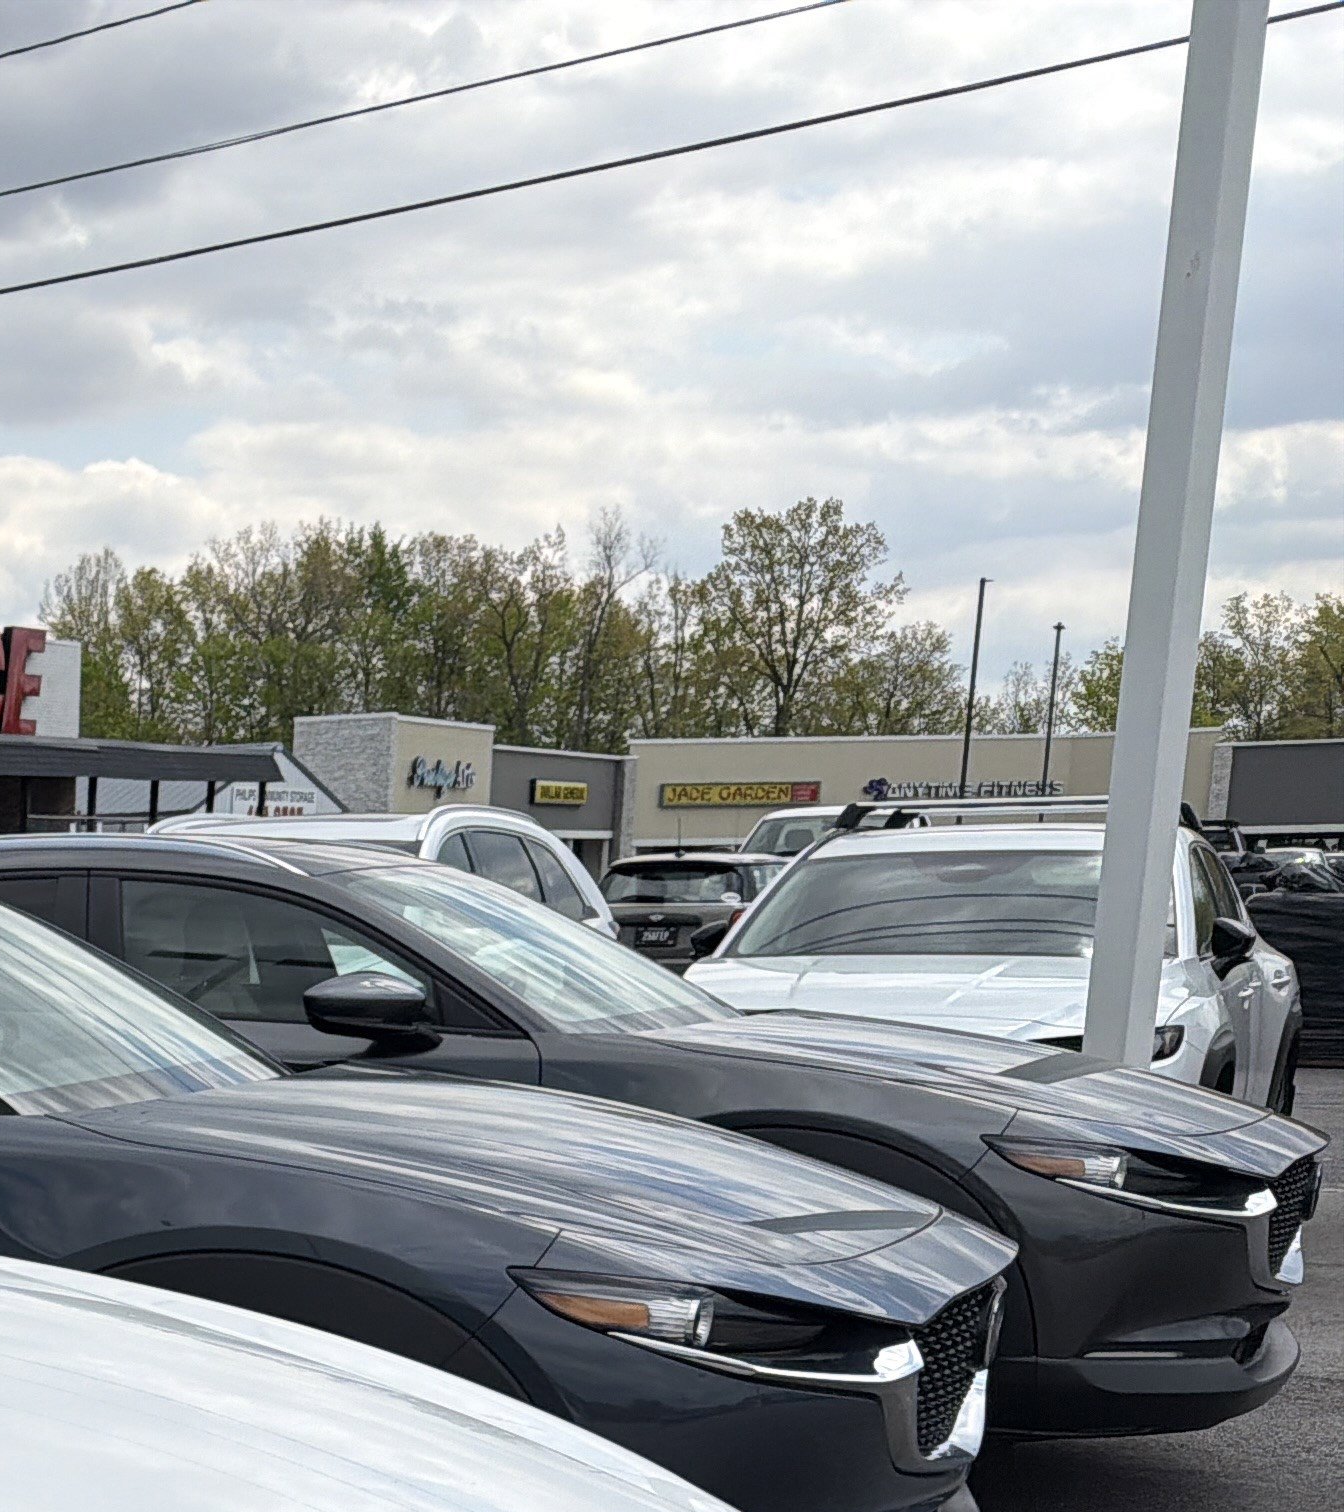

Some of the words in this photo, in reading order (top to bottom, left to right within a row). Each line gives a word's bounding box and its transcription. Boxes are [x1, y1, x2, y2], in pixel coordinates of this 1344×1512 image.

[667, 787, 711, 802] JADE
[718, 786, 789, 801] GARDEN
[886, 782, 976, 798] ANYTIME
[980, 780, 1063, 796] FITNESS
